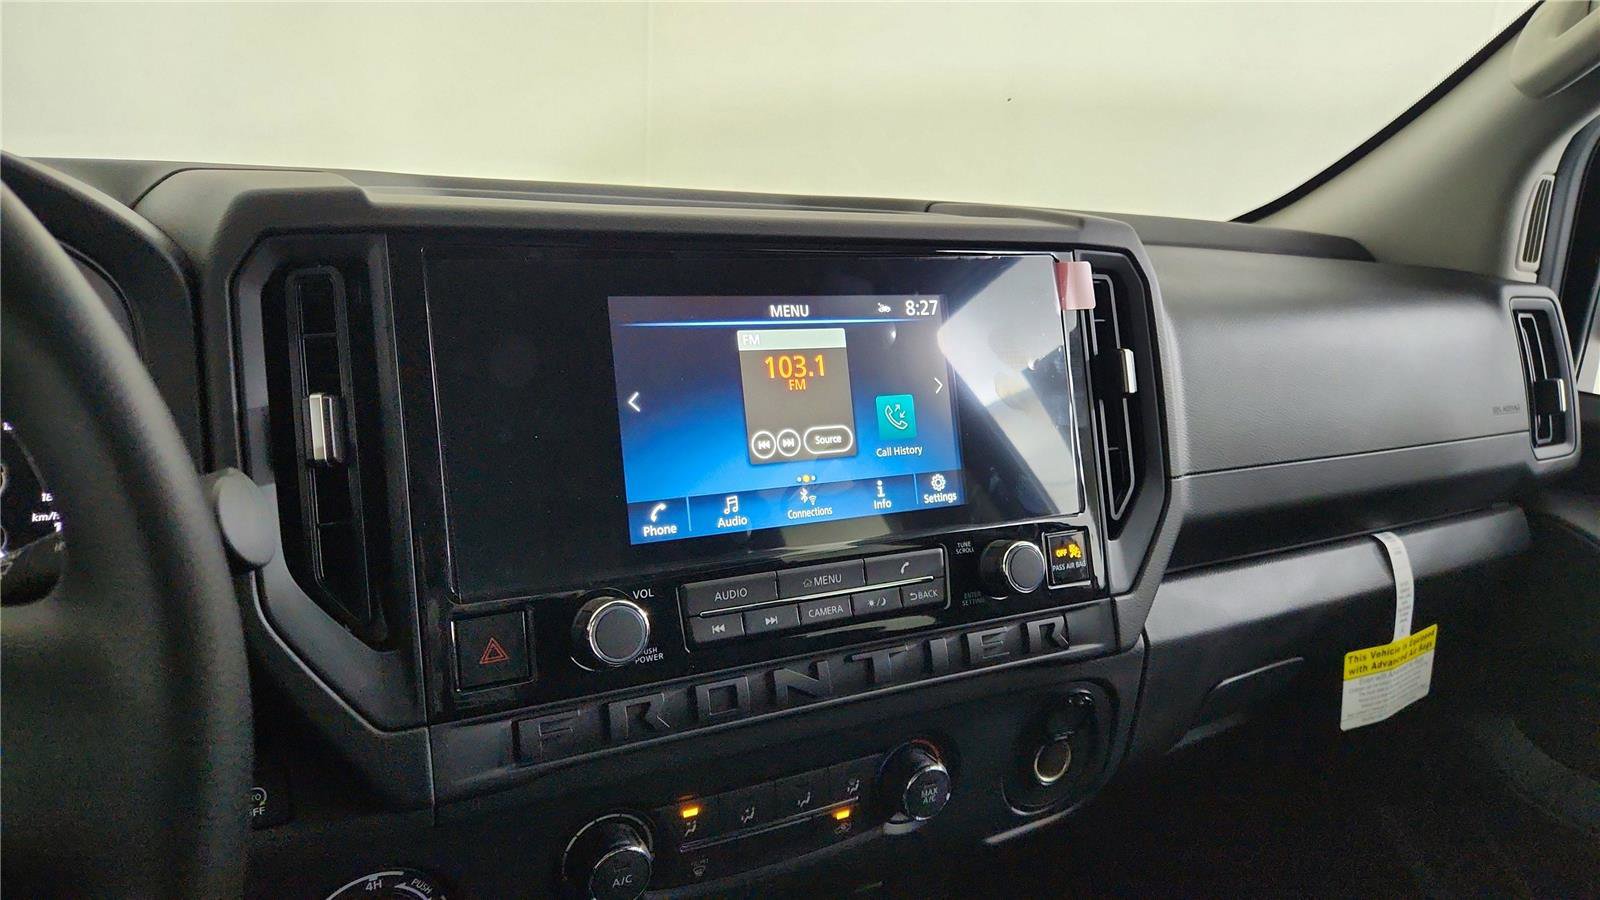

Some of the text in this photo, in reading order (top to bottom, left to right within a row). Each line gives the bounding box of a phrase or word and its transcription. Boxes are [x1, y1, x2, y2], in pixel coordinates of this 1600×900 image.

[769, 304, 810, 318] MENU
[905, 299, 939, 316] 8:27
[742, 333, 761, 347] FM
[764, 354, 826, 379] 103.1
[788, 378, 807, 391] FM
[815, 433, 842, 445] Source
[876, 445, 923, 458] Call History
[873, 498, 892, 509] Info
[923, 490, 957, 505] Settings
[787, 505, 833, 520] Connections
[717, 514, 748, 528] Audio
[643, 523, 678, 538] Phone
[955, 547, 975, 555] SCROLL
[1055, 548, 1068, 558] OFF
[1052, 563, 1066, 571] PASS
[1075, 560, 1087, 568] BAG
[814, 574, 842, 587] MENU
[632, 588, 655, 600] VOL
[714, 588, 748, 601] AUDIO
[918, 589, 939, 600] BACK
[808, 605, 844, 618] CAMERA
[643, 647, 658, 655] USH
[1348, 653, 1367, 664] This
[1348, 665, 1368, 675] with
[513, 614, 1071, 764] FRONTIER
[921, 786, 938, 799] MAX
[365, 879, 383, 892] 4H
[410, 878, 434, 895] PUSH
[612, 874, 633, 889] A/C
